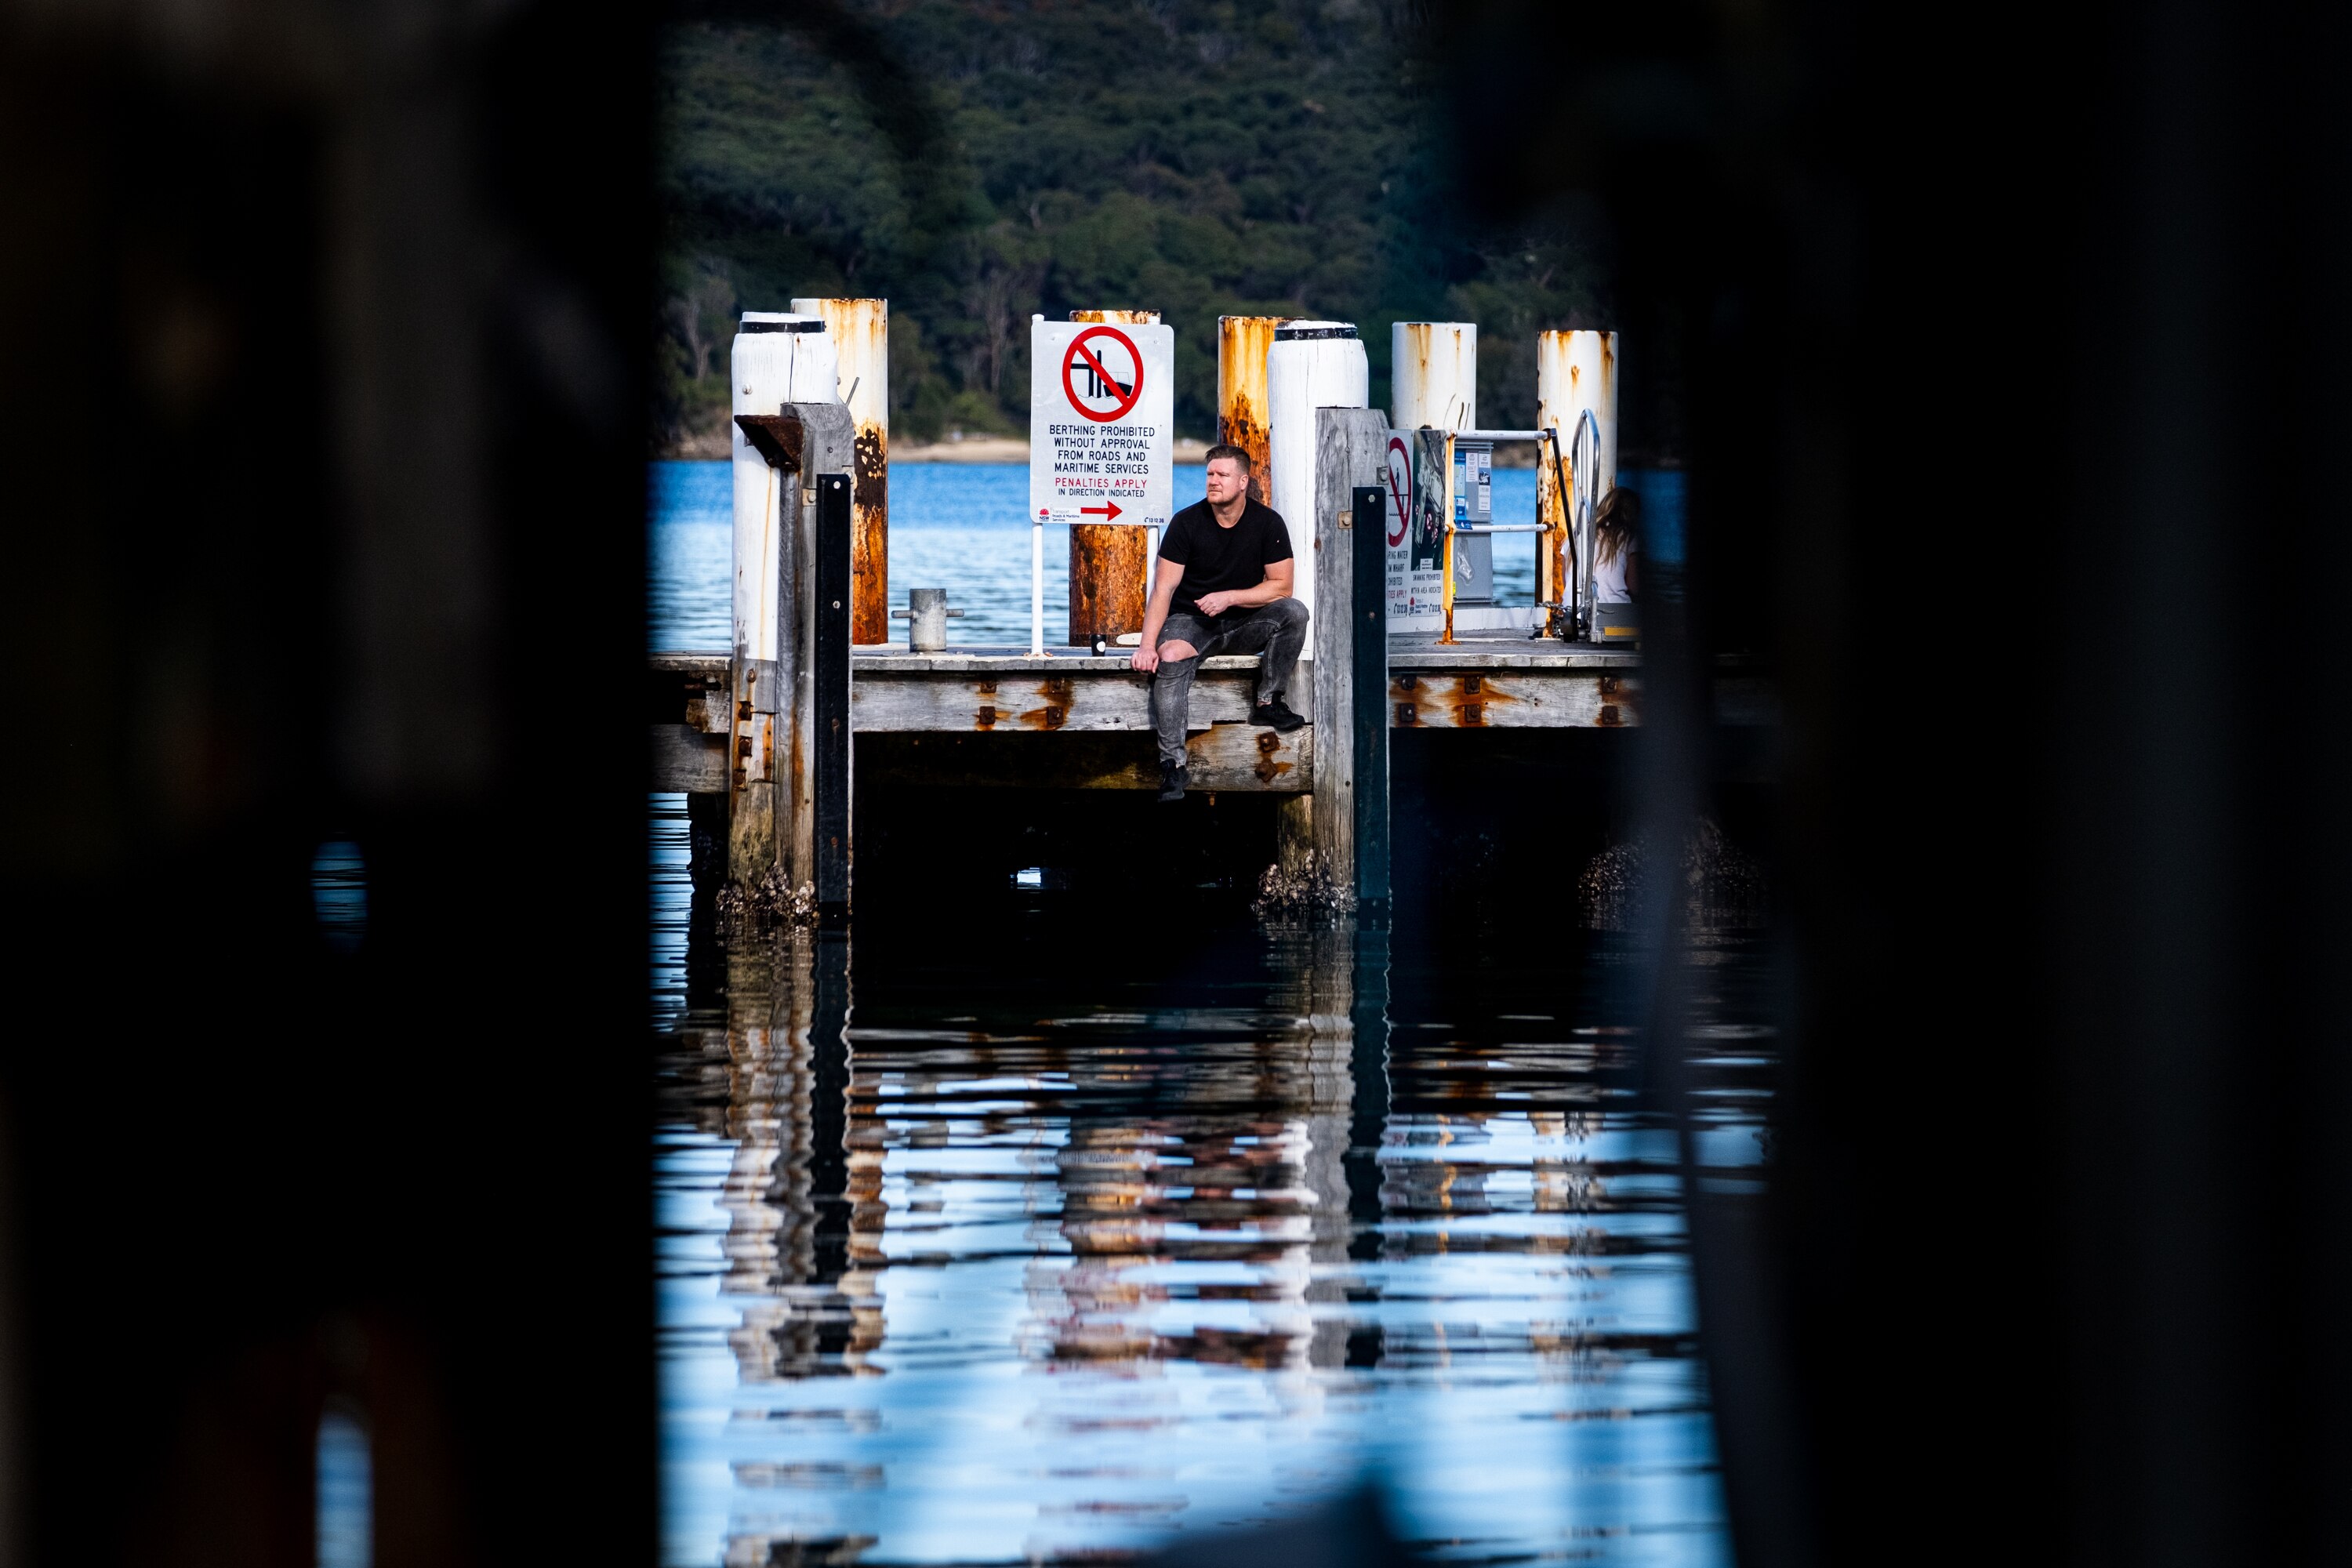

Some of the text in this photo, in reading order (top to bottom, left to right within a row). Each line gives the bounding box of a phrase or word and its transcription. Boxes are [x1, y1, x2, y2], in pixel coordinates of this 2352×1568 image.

[1049, 425, 1155, 437] BERTHING PROHIBITED
[1054, 437, 1150, 449] WITHOUT APPROVAL
[1058, 450, 1145, 462] FROM ROADS AND
[1054, 463, 1149, 474] MARITIME SERVICES
[1055, 477, 1147, 488] PENALTIES APPLY
[1069, 488, 1105, 497] DIRECTION
[1109, 489, 1145, 498] INDICATED
[1397, 550, 1408, 559] WATER
[1396, 590, 1407, 599] APPLY
